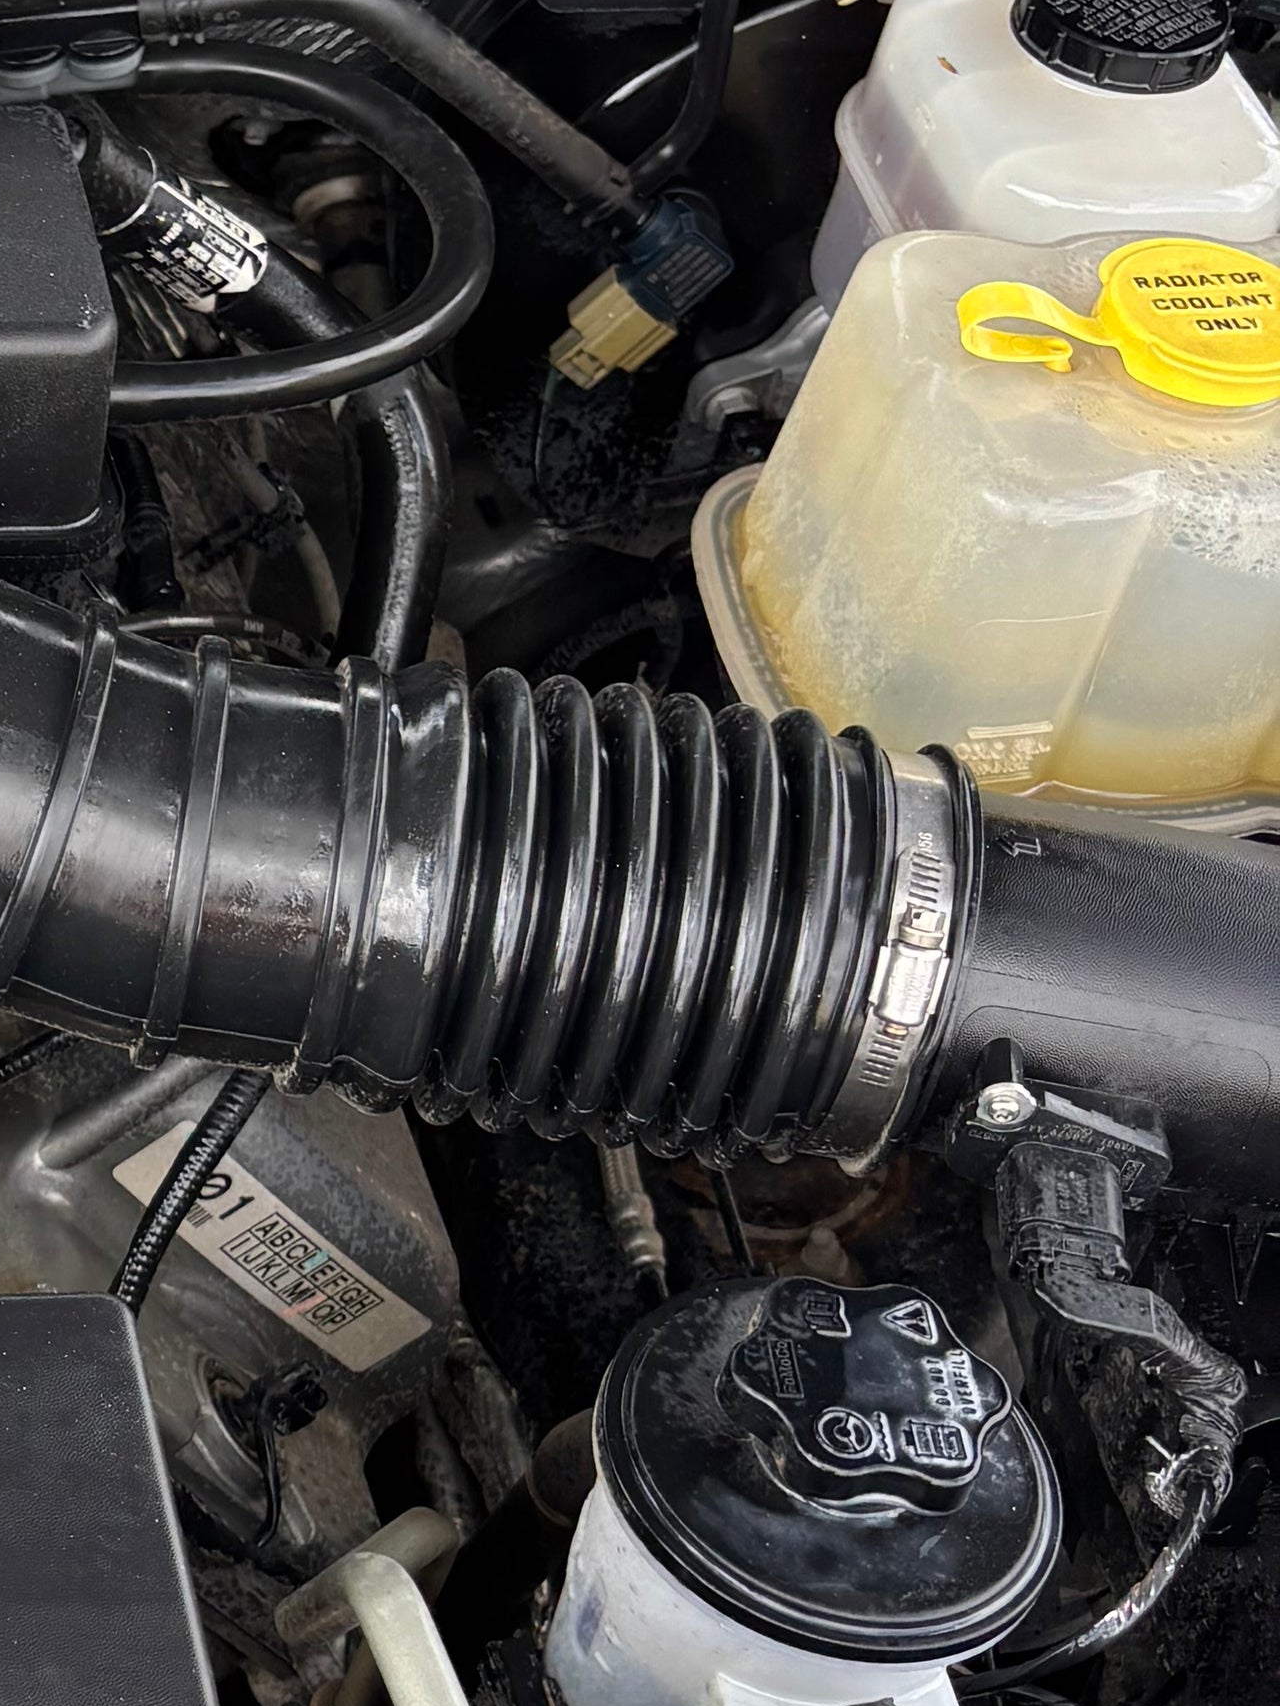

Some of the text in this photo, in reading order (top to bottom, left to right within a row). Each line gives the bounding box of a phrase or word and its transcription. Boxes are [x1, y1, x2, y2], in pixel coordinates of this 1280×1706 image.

[1133, 272, 1263, 289] RADIATOR
[1151, 294, 1272, 310] COOLANT
[1195, 317, 1259, 332] ONLY
[926, 1357, 952, 1408] DO NOT
[949, 1348, 979, 1417] OVERFILL
